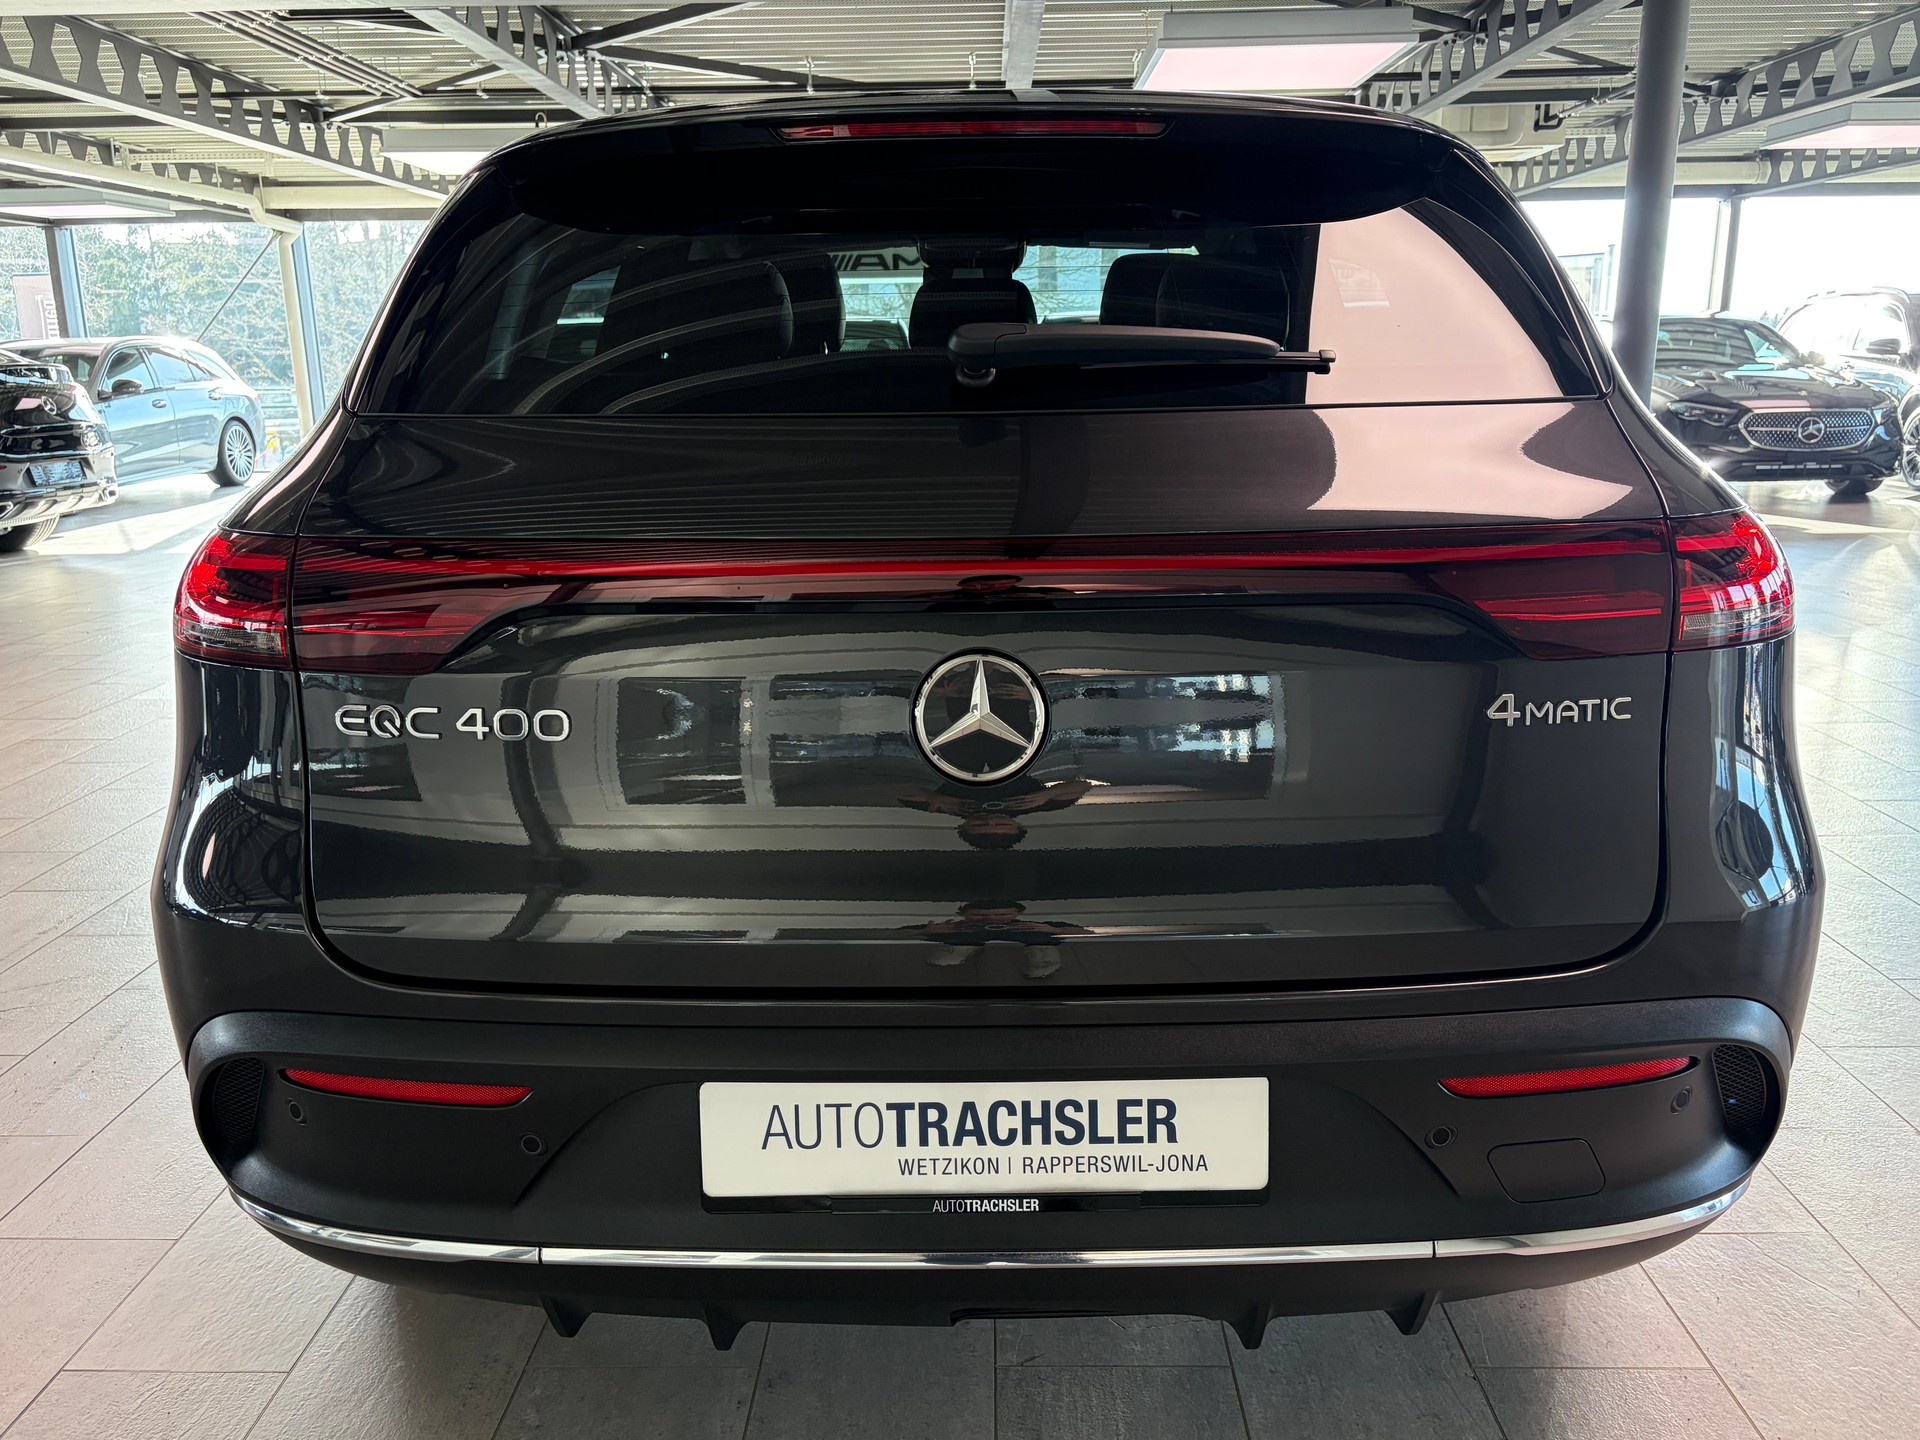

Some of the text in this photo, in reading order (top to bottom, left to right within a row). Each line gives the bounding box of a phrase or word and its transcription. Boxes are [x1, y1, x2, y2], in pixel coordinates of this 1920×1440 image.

[335, 704, 570, 742] EQC 400
[1487, 693, 1632, 727] 4MATIC
[761, 1098, 1179, 1150] AUTOTRACHSLER
[897, 1157, 1000, 1176] WETZIKON
[1022, 1154, 1209, 1175] RAPPERSWIL-JONA
[932, 1198, 1040, 1213] AUTOTRACHSLER
